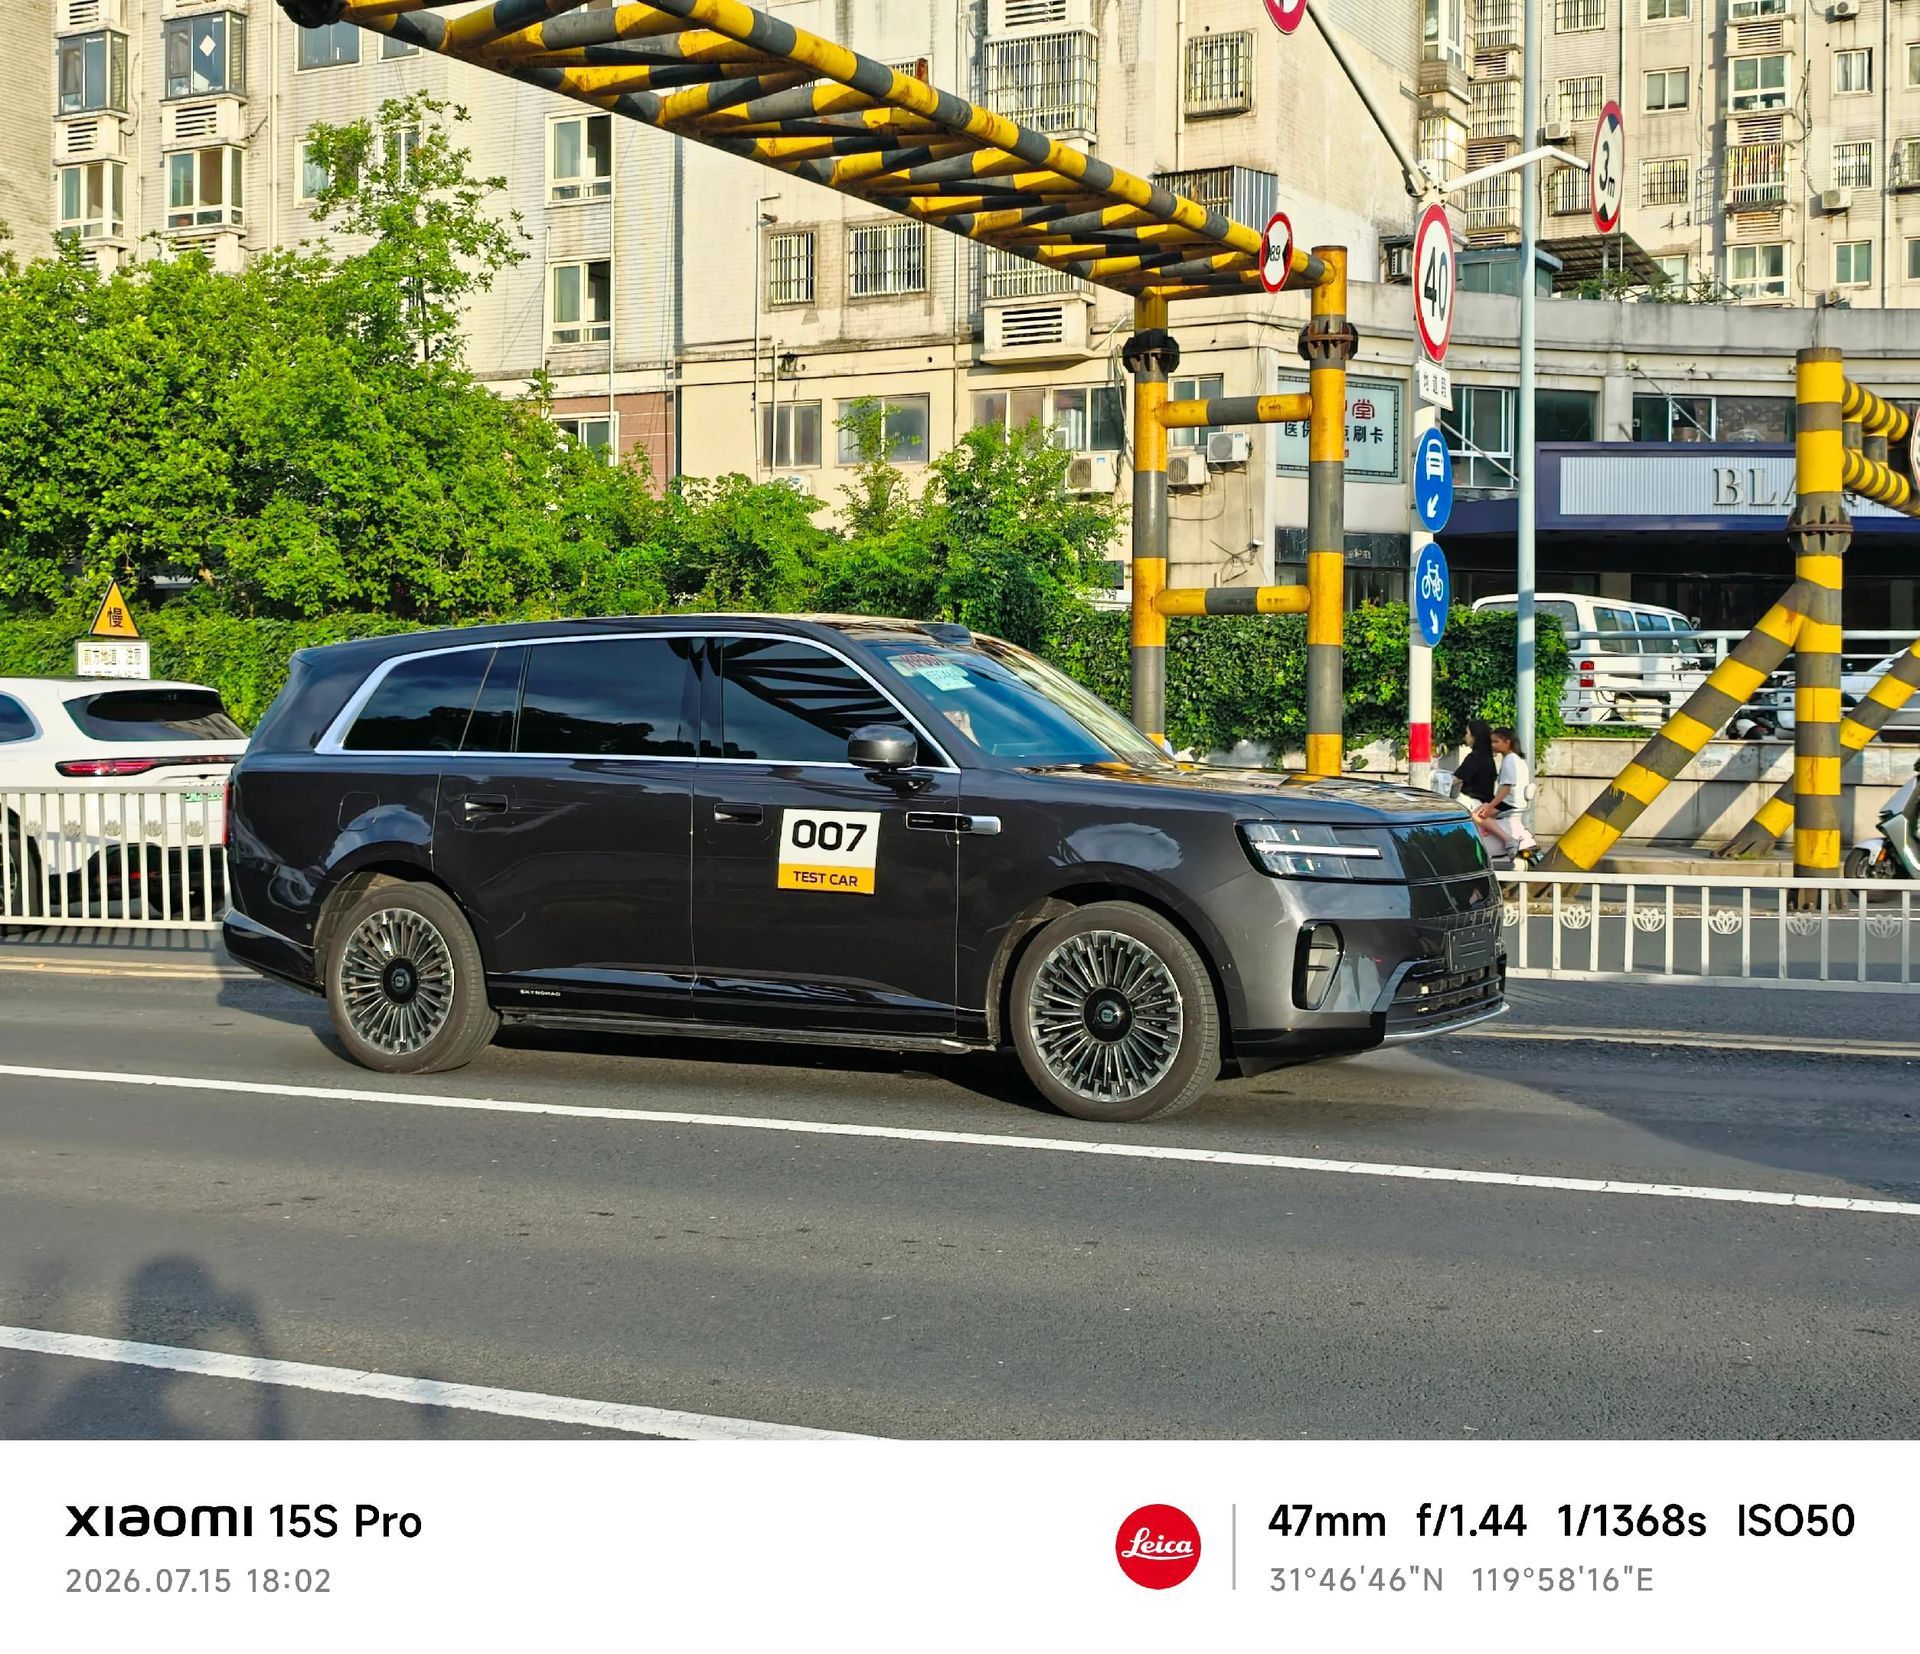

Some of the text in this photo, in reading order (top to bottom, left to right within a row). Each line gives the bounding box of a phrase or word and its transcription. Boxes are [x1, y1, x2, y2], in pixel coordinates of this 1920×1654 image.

[1424, 246, 1448, 322] 40
[1344, 398, 1375, 420] 堂
[107, 606, 123, 628] 慢
[791, 818, 868, 852] 007
[793, 870, 858, 887] TEST CAR
